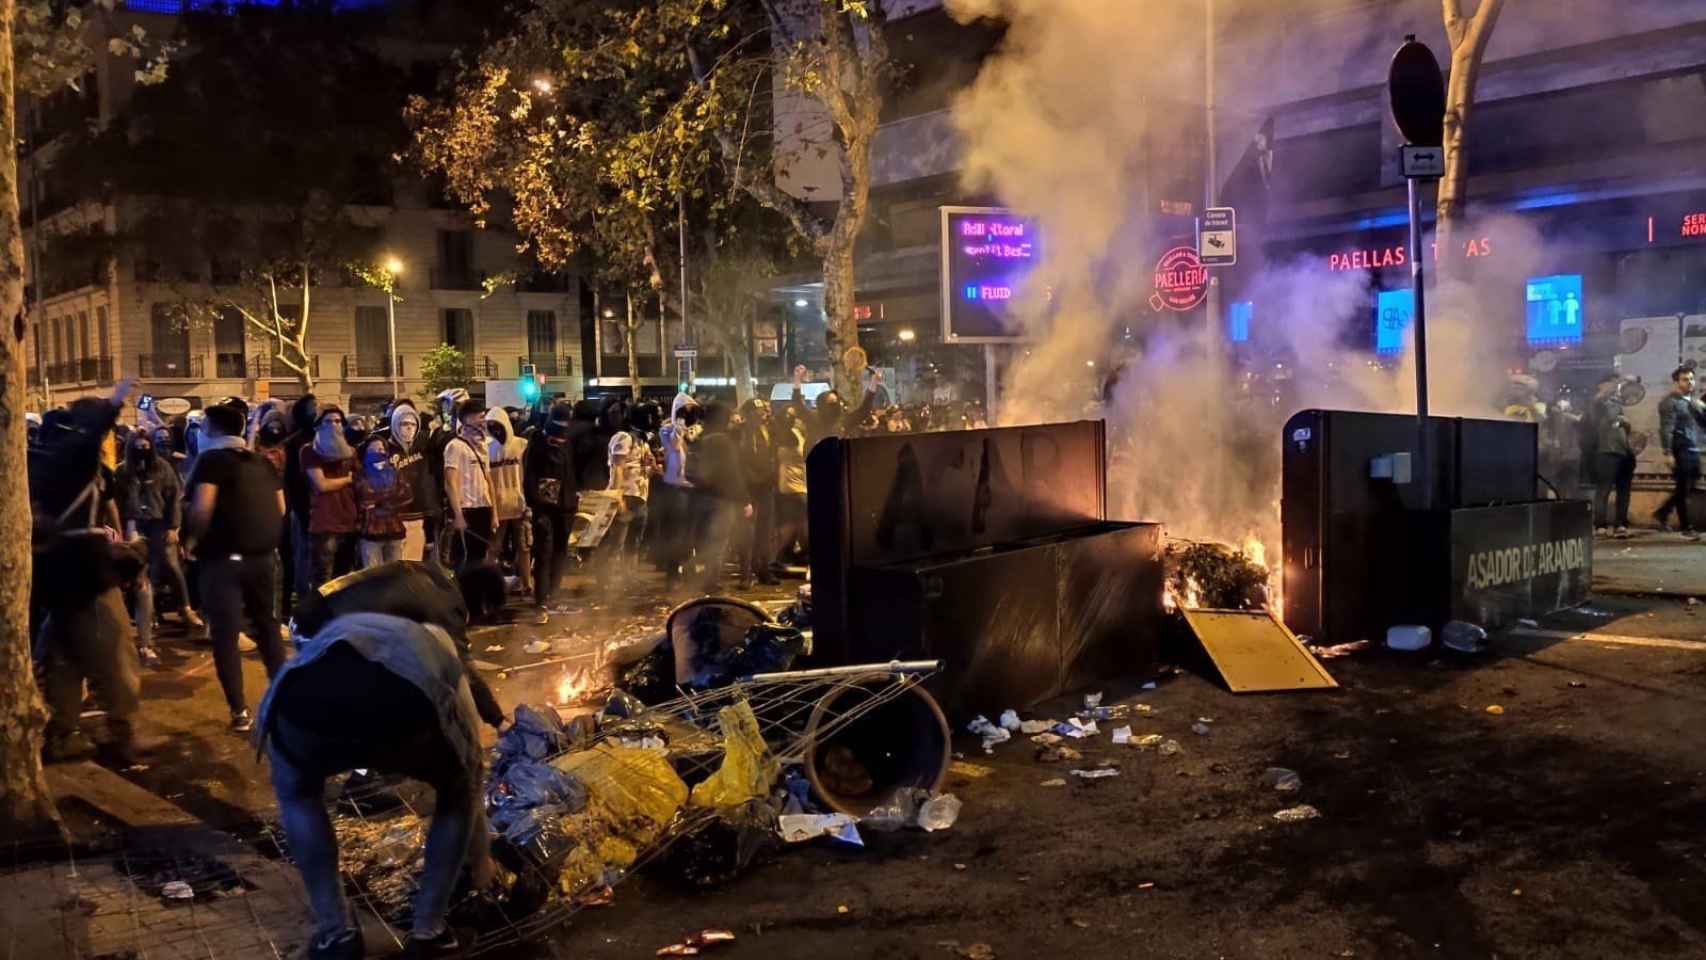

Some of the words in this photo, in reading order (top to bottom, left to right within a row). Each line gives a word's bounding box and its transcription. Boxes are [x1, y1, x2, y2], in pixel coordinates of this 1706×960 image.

[1330, 247, 1405, 271] PAELLAS
[982, 287, 1010, 299] FLUID
[1467, 547, 1521, 588] ASADOR
[1538, 536, 1584, 576] ARANDA
